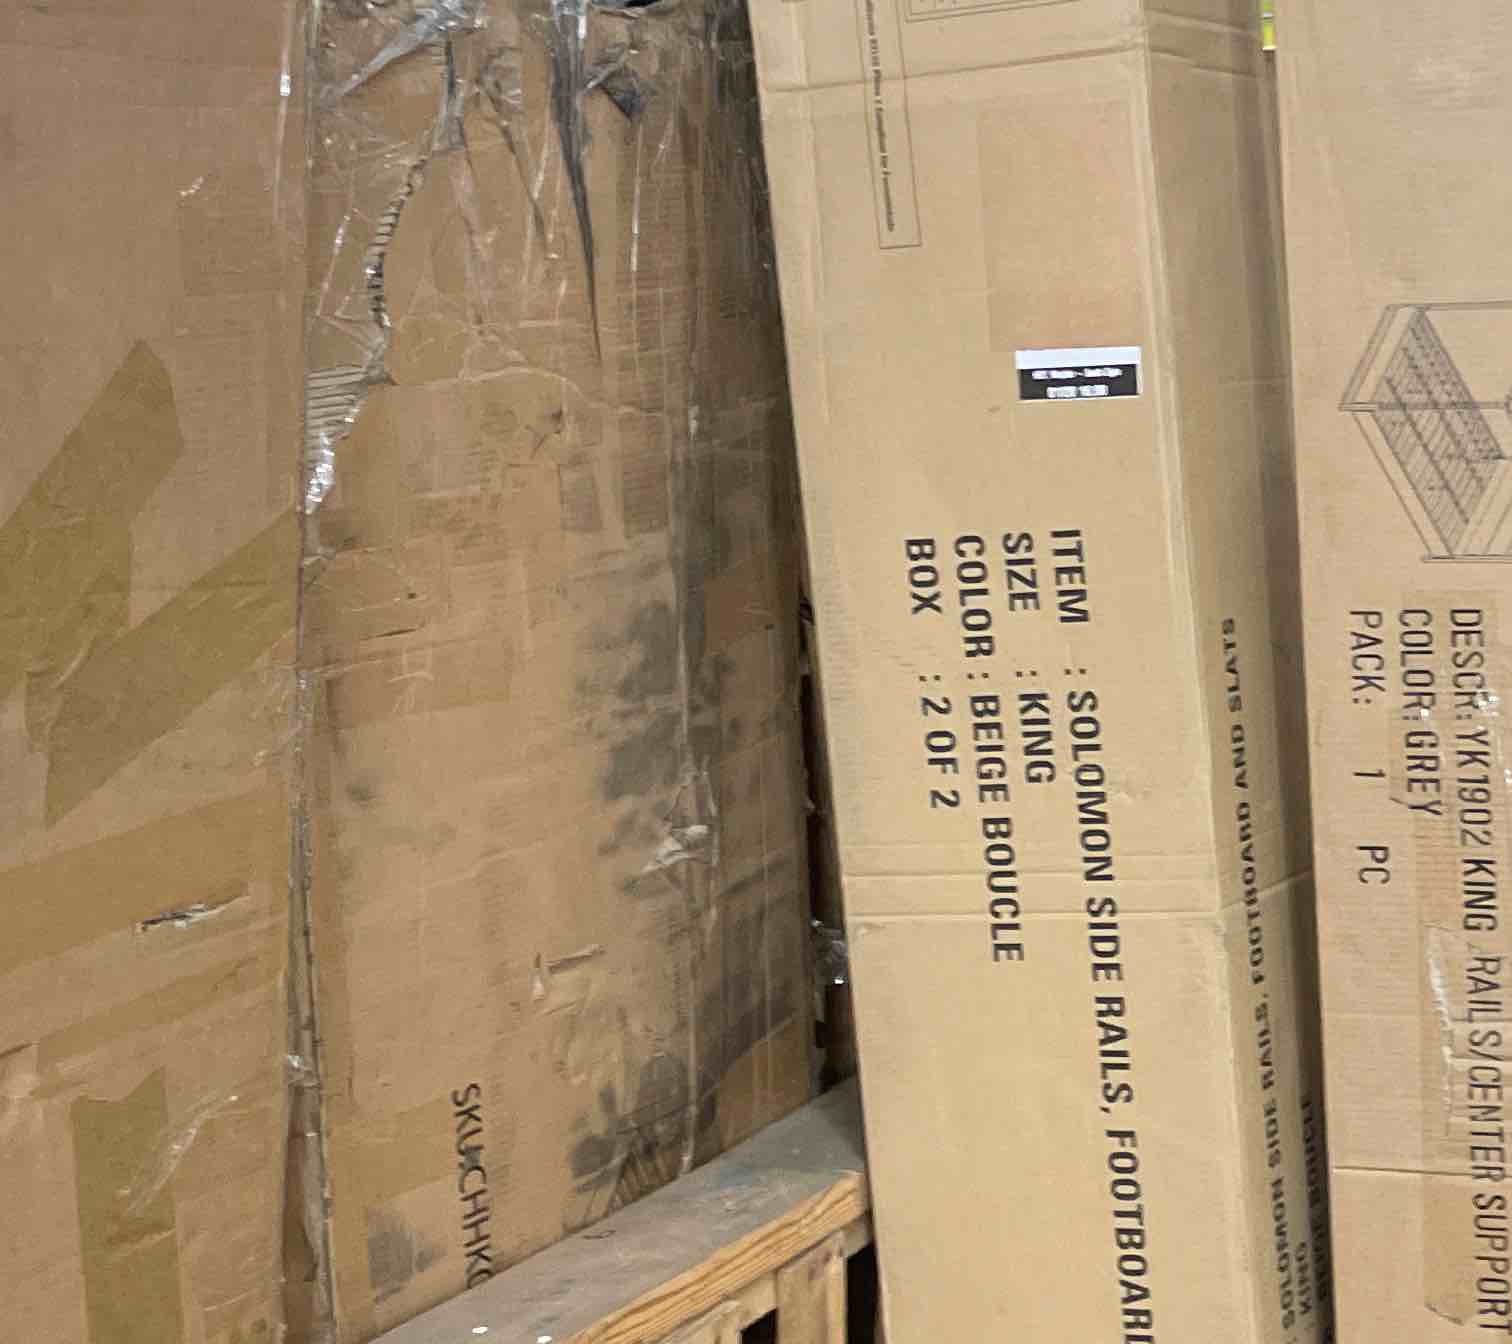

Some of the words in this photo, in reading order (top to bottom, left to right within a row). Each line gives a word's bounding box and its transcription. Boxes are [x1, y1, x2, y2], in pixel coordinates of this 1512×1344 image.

[904, 537, 942, 616] BOX
[953, 533, 995, 659] COLOR
[1001, 532, 1041, 614] SIZE
[1050, 528, 1092, 625] ITEM
[920, 694, 952, 716] 2
[1220, 617, 1241, 713] SLATS
[1349, 609, 1386, 705] PACK:
[1398, 607, 1436, 722] COLOR:
[1449, 607, 1484, 721] DESCR:
[926, 730, 960, 776] OF
[968, 692, 1011, 804] BEIGE
[1018, 690, 1057, 785] KING
[1231, 724, 1249, 790] AND
[1404, 730, 1442, 817] GREY
[929, 787, 960, 810] 2
[1066, 690, 1116, 885] SOLOMON
[1455, 731, 1495, 848] YK1902
[981, 815, 1024, 964] BOUCLE
[1236, 801, 1266, 985] FOOTBOARD
[1356, 845, 1391, 886] PC
[1461, 857, 1498, 933] KING
[1086, 896, 1124, 983] SIDE
[1094, 995, 1134, 1114] RAILS,
[1262, 1098, 1282, 1169] SIDE
[1270, 1176, 1297, 1331] SOLOMON
